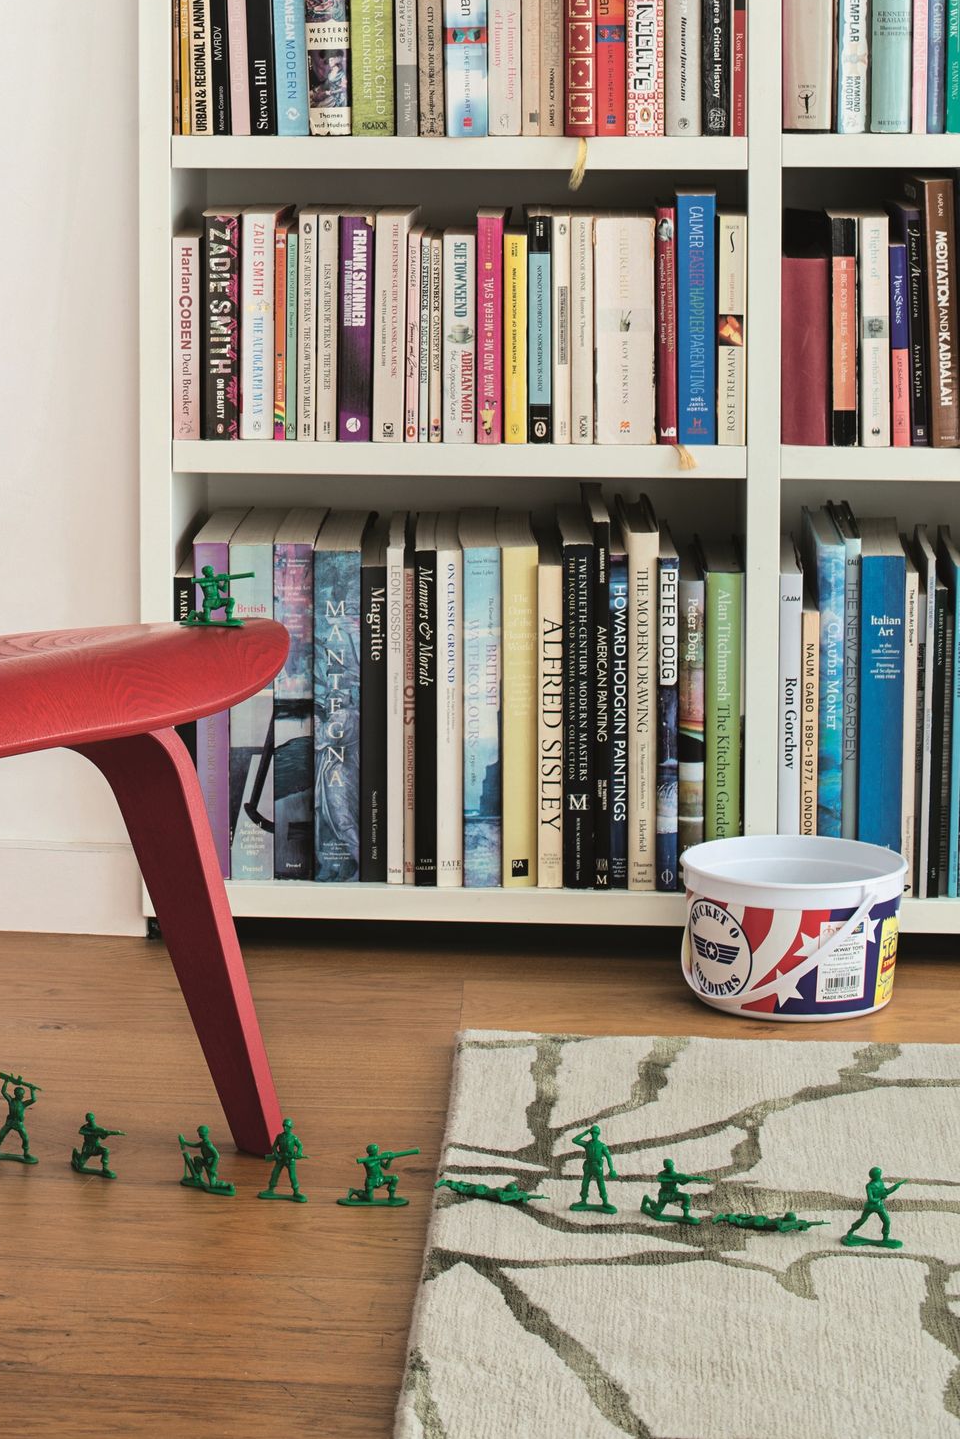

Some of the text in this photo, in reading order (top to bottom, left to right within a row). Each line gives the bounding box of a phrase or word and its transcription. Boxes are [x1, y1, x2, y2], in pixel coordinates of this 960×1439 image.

[194, 41, 207, 87] REGIONAL
[713, 27, 722, 60] Critical
[735, 53, 743, 72] King
[736, 33, 744, 51] Ross
[194, 87, 208, 98] &
[195, 99, 208, 132] URBAN
[255, 59, 268, 129] Steven Holl
[712, 64, 722, 98] History
[352, 229, 367, 327] FRANK SKINNER
[454, 242, 467, 318] SUE TOWNSEND
[935, 231, 949, 307] MEDITATION
[179, 247, 192, 416] Harlan COBEN Deal Breaker
[209, 228, 231, 419] ZADIE SMITH ON BEAUTY
[939, 308, 949, 331] AND
[461, 350, 472, 423] ADRIAN MOLE
[938, 332, 952, 406] KABBALAH
[366, 587, 385, 661] Magritte
[418, 566, 432, 686] Manners & Morals
[636, 568, 649, 733] THE MODERN DRAWING
[661, 572, 675, 679] PETER DOIG
[805, 643, 815, 677] NAUM
[540, 617, 562, 832] ALFRED SISLEY
[613, 585, 626, 821] HOWARD HODGKIN PAINTINGS
[782, 678, 797, 769] Ron Gorchov
[804, 682, 814, 713] GABO
[802, 790, 812, 836] LONDON
[691, 905, 730, 926] BUCKET
[695, 962, 741, 996] SOLDIERS
